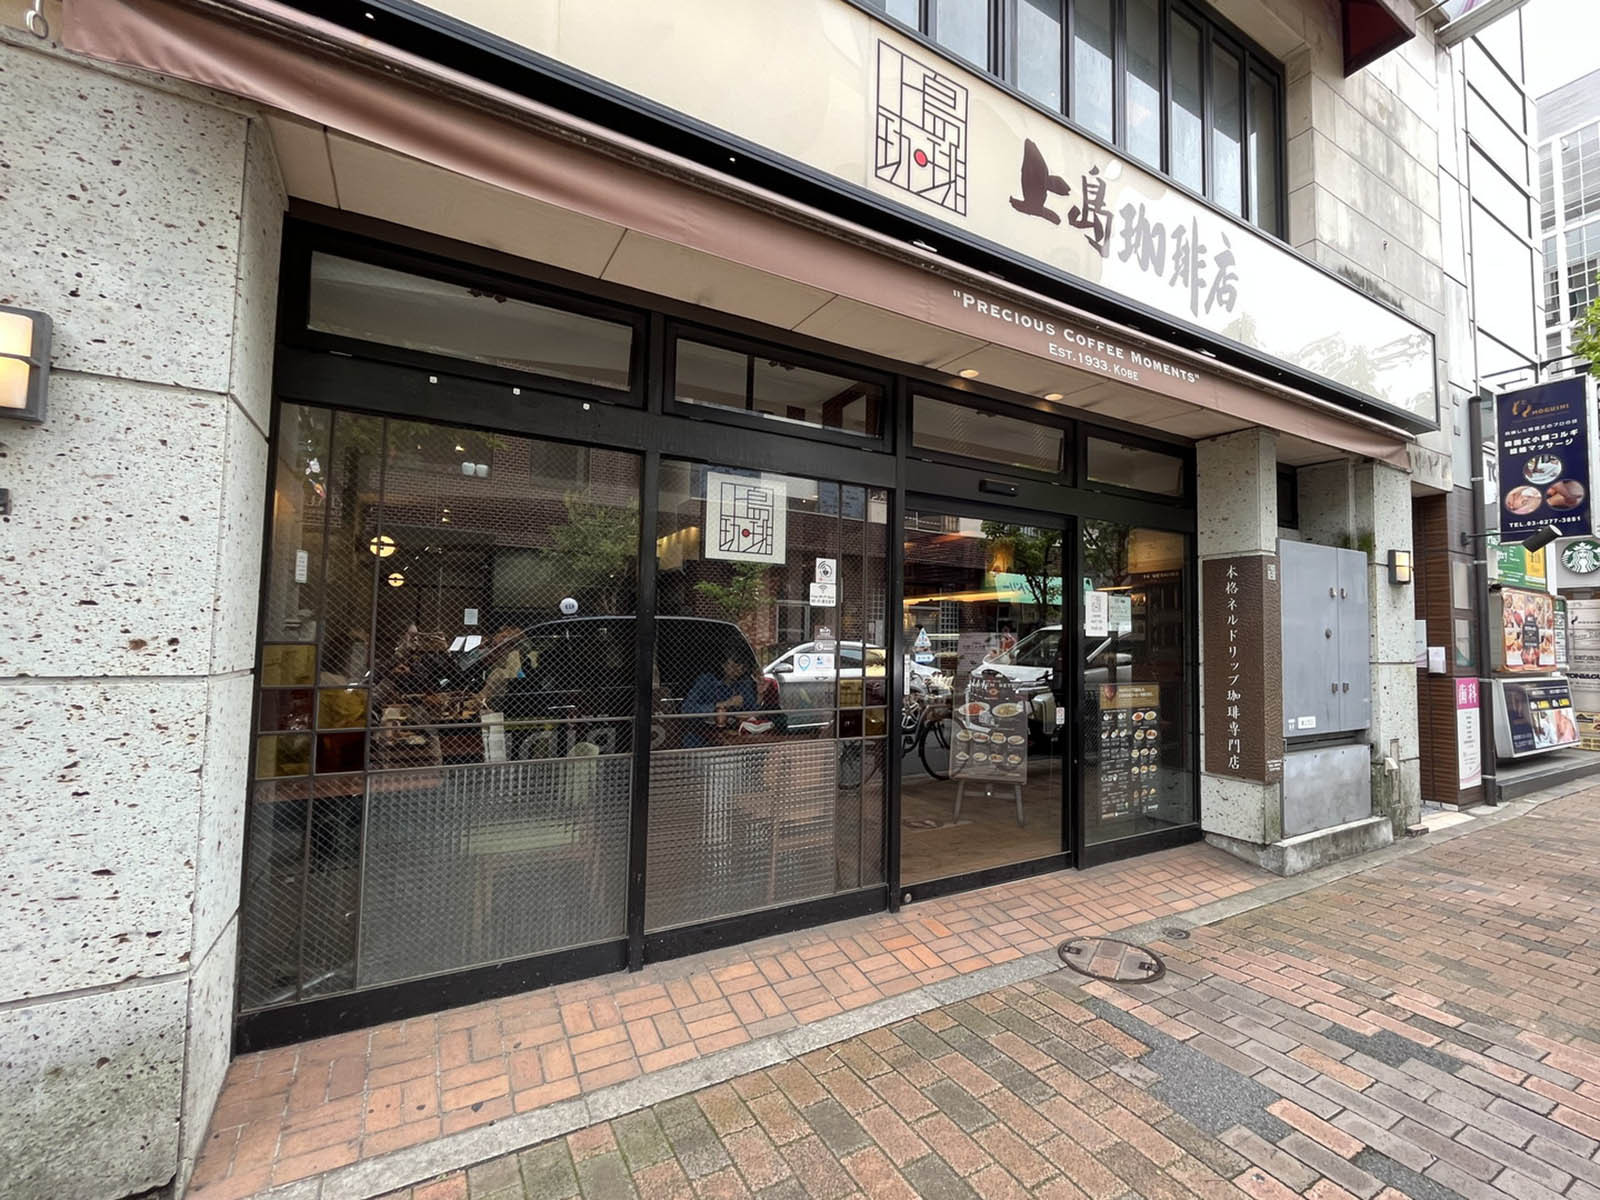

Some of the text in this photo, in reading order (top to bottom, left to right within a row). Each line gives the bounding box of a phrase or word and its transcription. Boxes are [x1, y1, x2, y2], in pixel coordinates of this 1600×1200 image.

[1009, 138, 1239, 317] 上島珈琲店
[953, 289, 1200, 383] "PRECIOUS COFFEE MOMENTS"
[1225, 564, 1241, 770] 本格ネルドリップ珈琲専門店
